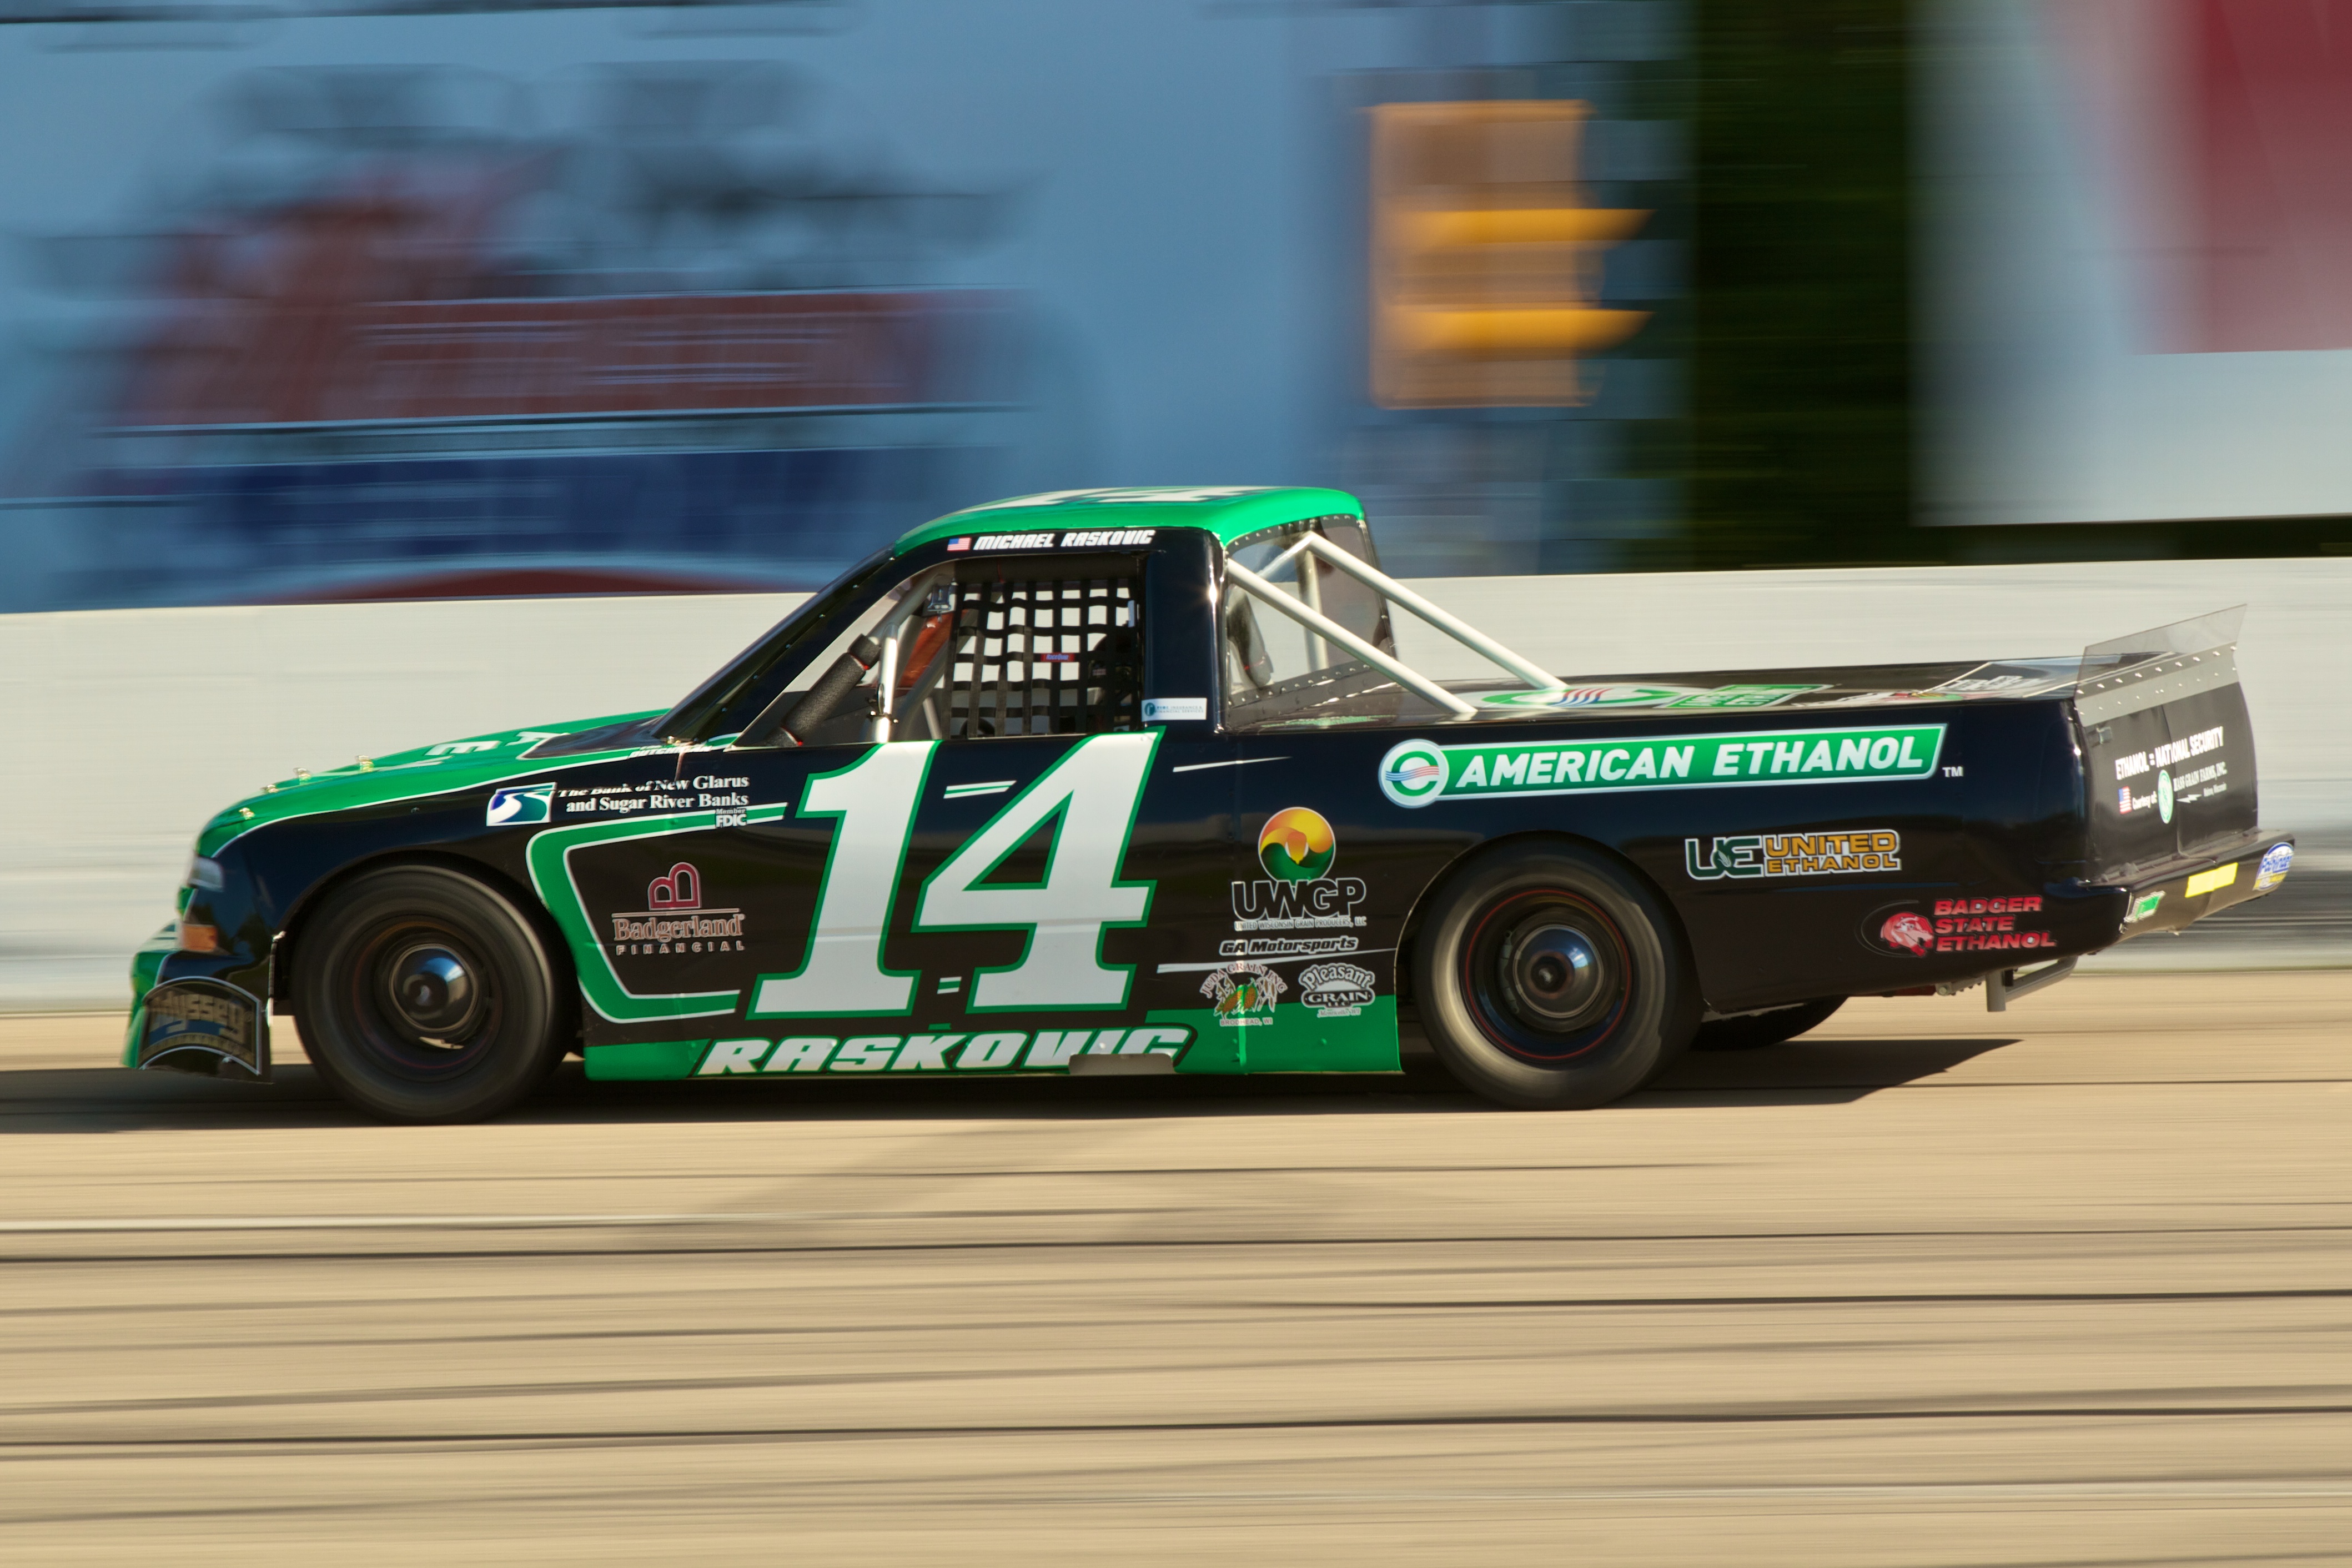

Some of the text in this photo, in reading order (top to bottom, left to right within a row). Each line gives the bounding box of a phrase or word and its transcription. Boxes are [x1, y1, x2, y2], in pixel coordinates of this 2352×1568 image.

[973, 529, 1156, 551] MICHAEL RASKOVIC
[1456, 745, 1695, 788] AMERICAN
[1711, 735, 1924, 777] ETHANOL
[2115, 751, 2150, 780] ETHANOL
[2154, 738, 2191, 768] NATIONAL
[2189, 726, 2224, 756] SECURITY
[635, 780, 655, 792] of
[654, 779, 691, 791] New
[692, 775, 750, 790] Glarus
[566, 792, 750, 814] and Sugar River Banks
[716, 814, 747, 828] FDIC
[1766, 832, 1897, 857] UNITED
[746, 726, 1164, 1019] 14
[1766, 854, 1897, 873] ETHANOL
[1232, 877, 1366, 921] UWGP
[1934, 896, 2043, 916] BADGER
[612, 913, 744, 943] Badgerland
[1234, 916, 1367, 931] UNITED WISCONSIN GRAIN PRODUCERS, LLC
[1934, 915, 2015, 934] STATE
[615, 940, 746, 956] FINANCIAL
[1219, 935, 1359, 956] GA Motorsports
[1936, 932, 2057, 952] ETHANOL
[1199, 962, 1289, 999] JUDA GRAIN INC
[1301, 966, 1371, 990] Pleasant
[1308, 991, 1369, 1003] GRAIN
[1219, 1018, 1263, 1027] BRODHEAD,
[696, 1026, 1192, 1075] RASKOVIC
